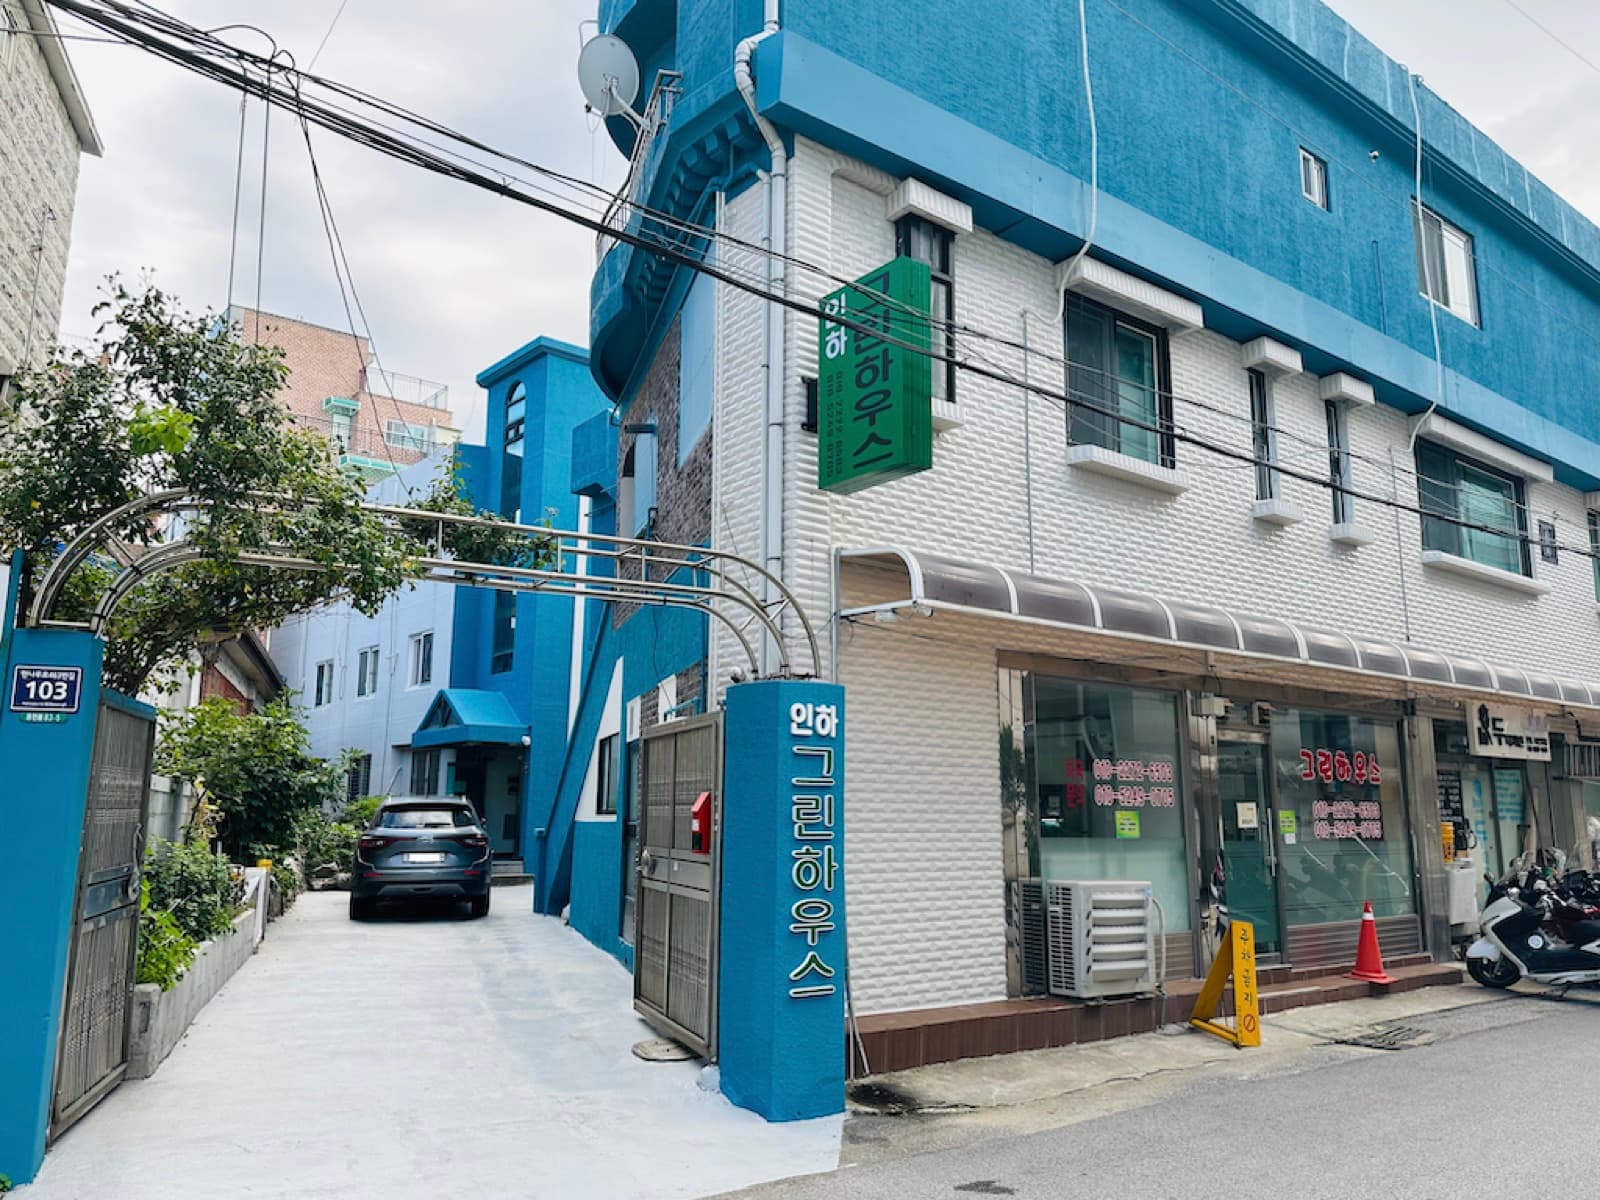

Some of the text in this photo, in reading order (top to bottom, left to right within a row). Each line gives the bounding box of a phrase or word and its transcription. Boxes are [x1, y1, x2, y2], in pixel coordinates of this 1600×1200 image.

[825, 293, 848, 360] 인하
[853, 270, 894, 469] 그린하우스
[26, 680, 68, 700] 103
[790, 703, 838, 737] 인하
[1300, 749, 1382, 784] 그린하우스
[789, 746, 838, 998] 그린하우스
